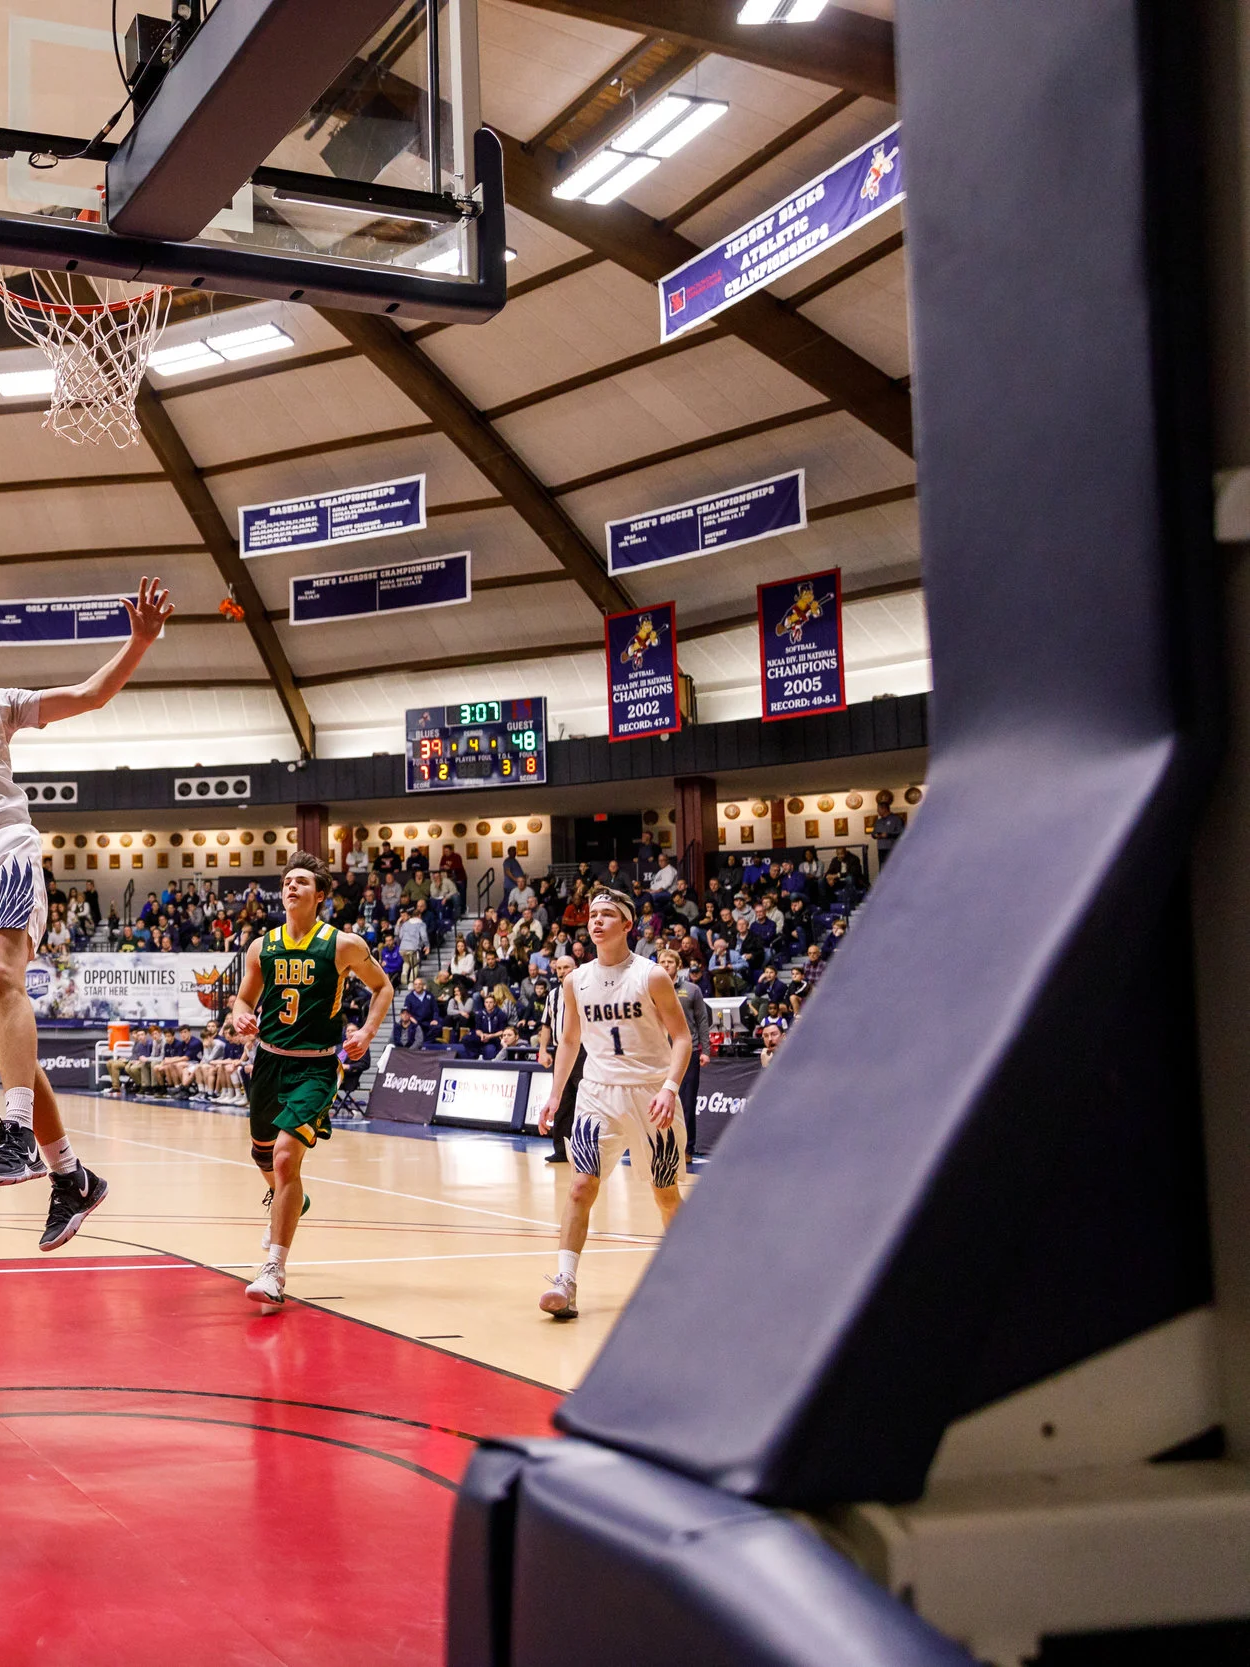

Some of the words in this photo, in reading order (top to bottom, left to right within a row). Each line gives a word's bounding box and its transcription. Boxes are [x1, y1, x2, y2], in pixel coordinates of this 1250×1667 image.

[724, 216, 775, 259] JERSEY
[778, 183, 825, 226] BLUES
[740, 215, 809, 271] ATHLETIC
[724, 223, 829, 299] CHAMPIONSHIPS
[270, 501, 316, 516] BASEBALL
[319, 486, 395, 508] CHAMPIONSHIPS
[630, 515, 657, 532] MEN'S
[660, 508, 693, 525] SOCCER
[696, 485, 774, 515] CHAMPIONSHIPS
[313, 578, 336, 588] MEN'S
[338, 572, 377, 585] LACROSSE
[380, 561, 446, 578] CHAMPIONSHIPS
[26, 604, 47, 612] GOLF
[785, 642, 817, 654] SOFTBALL
[767, 658, 786, 668] NJCAA
[786, 656, 798, 665] DIV.
[806, 648, 837, 661] NATIONAL
[628, 669, 655, 680] SOFTBALL
[767, 658, 838, 680] CHAMPIONS
[613, 683, 629, 692] NJCAA
[629, 681, 639, 690] DIV.
[647, 675, 672, 686] NATIONAL
[783, 676, 823, 696] 2005
[613, 683, 673, 703] CHAMPIONS
[627, 701, 660, 719] 2002
[771, 698, 810, 712] RECORD:
[812, 694, 837, 706] 49-8-1
[461, 701, 499, 724] 3:07
[507, 720, 534, 731] GUEST
[618, 720, 652, 733] RECORD:
[654, 717, 670, 728] 47-9
[415, 729, 440, 740] BLUES
[511, 730, 536, 752] 48
[420, 738, 442, 760] 39
[469, 739, 479, 752] 4
[455, 755, 476, 763] PLAYER
[478, 753, 492, 761] FOUL
[526, 757, 537, 774] 8
[420, 765, 430, 780] 7
[438, 763, 449, 780] 2
[502, 759, 512, 775] 3
[413, 782, 430, 790] SCORE
[519, 774, 537, 783] SCORE
[84, 970, 175, 986] OPPORTUNITIES
[274, 958, 315, 985] RBC
[25, 973, 51, 989] JCAA
[84, 986, 106, 996] START
[108, 986, 129, 996] HERE
[278, 987, 300, 1026] 3
[584, 1001, 643, 1022] EAGLES
[609, 1026, 624, 1056] 1
[39, 1055, 90, 1071] opGrou
